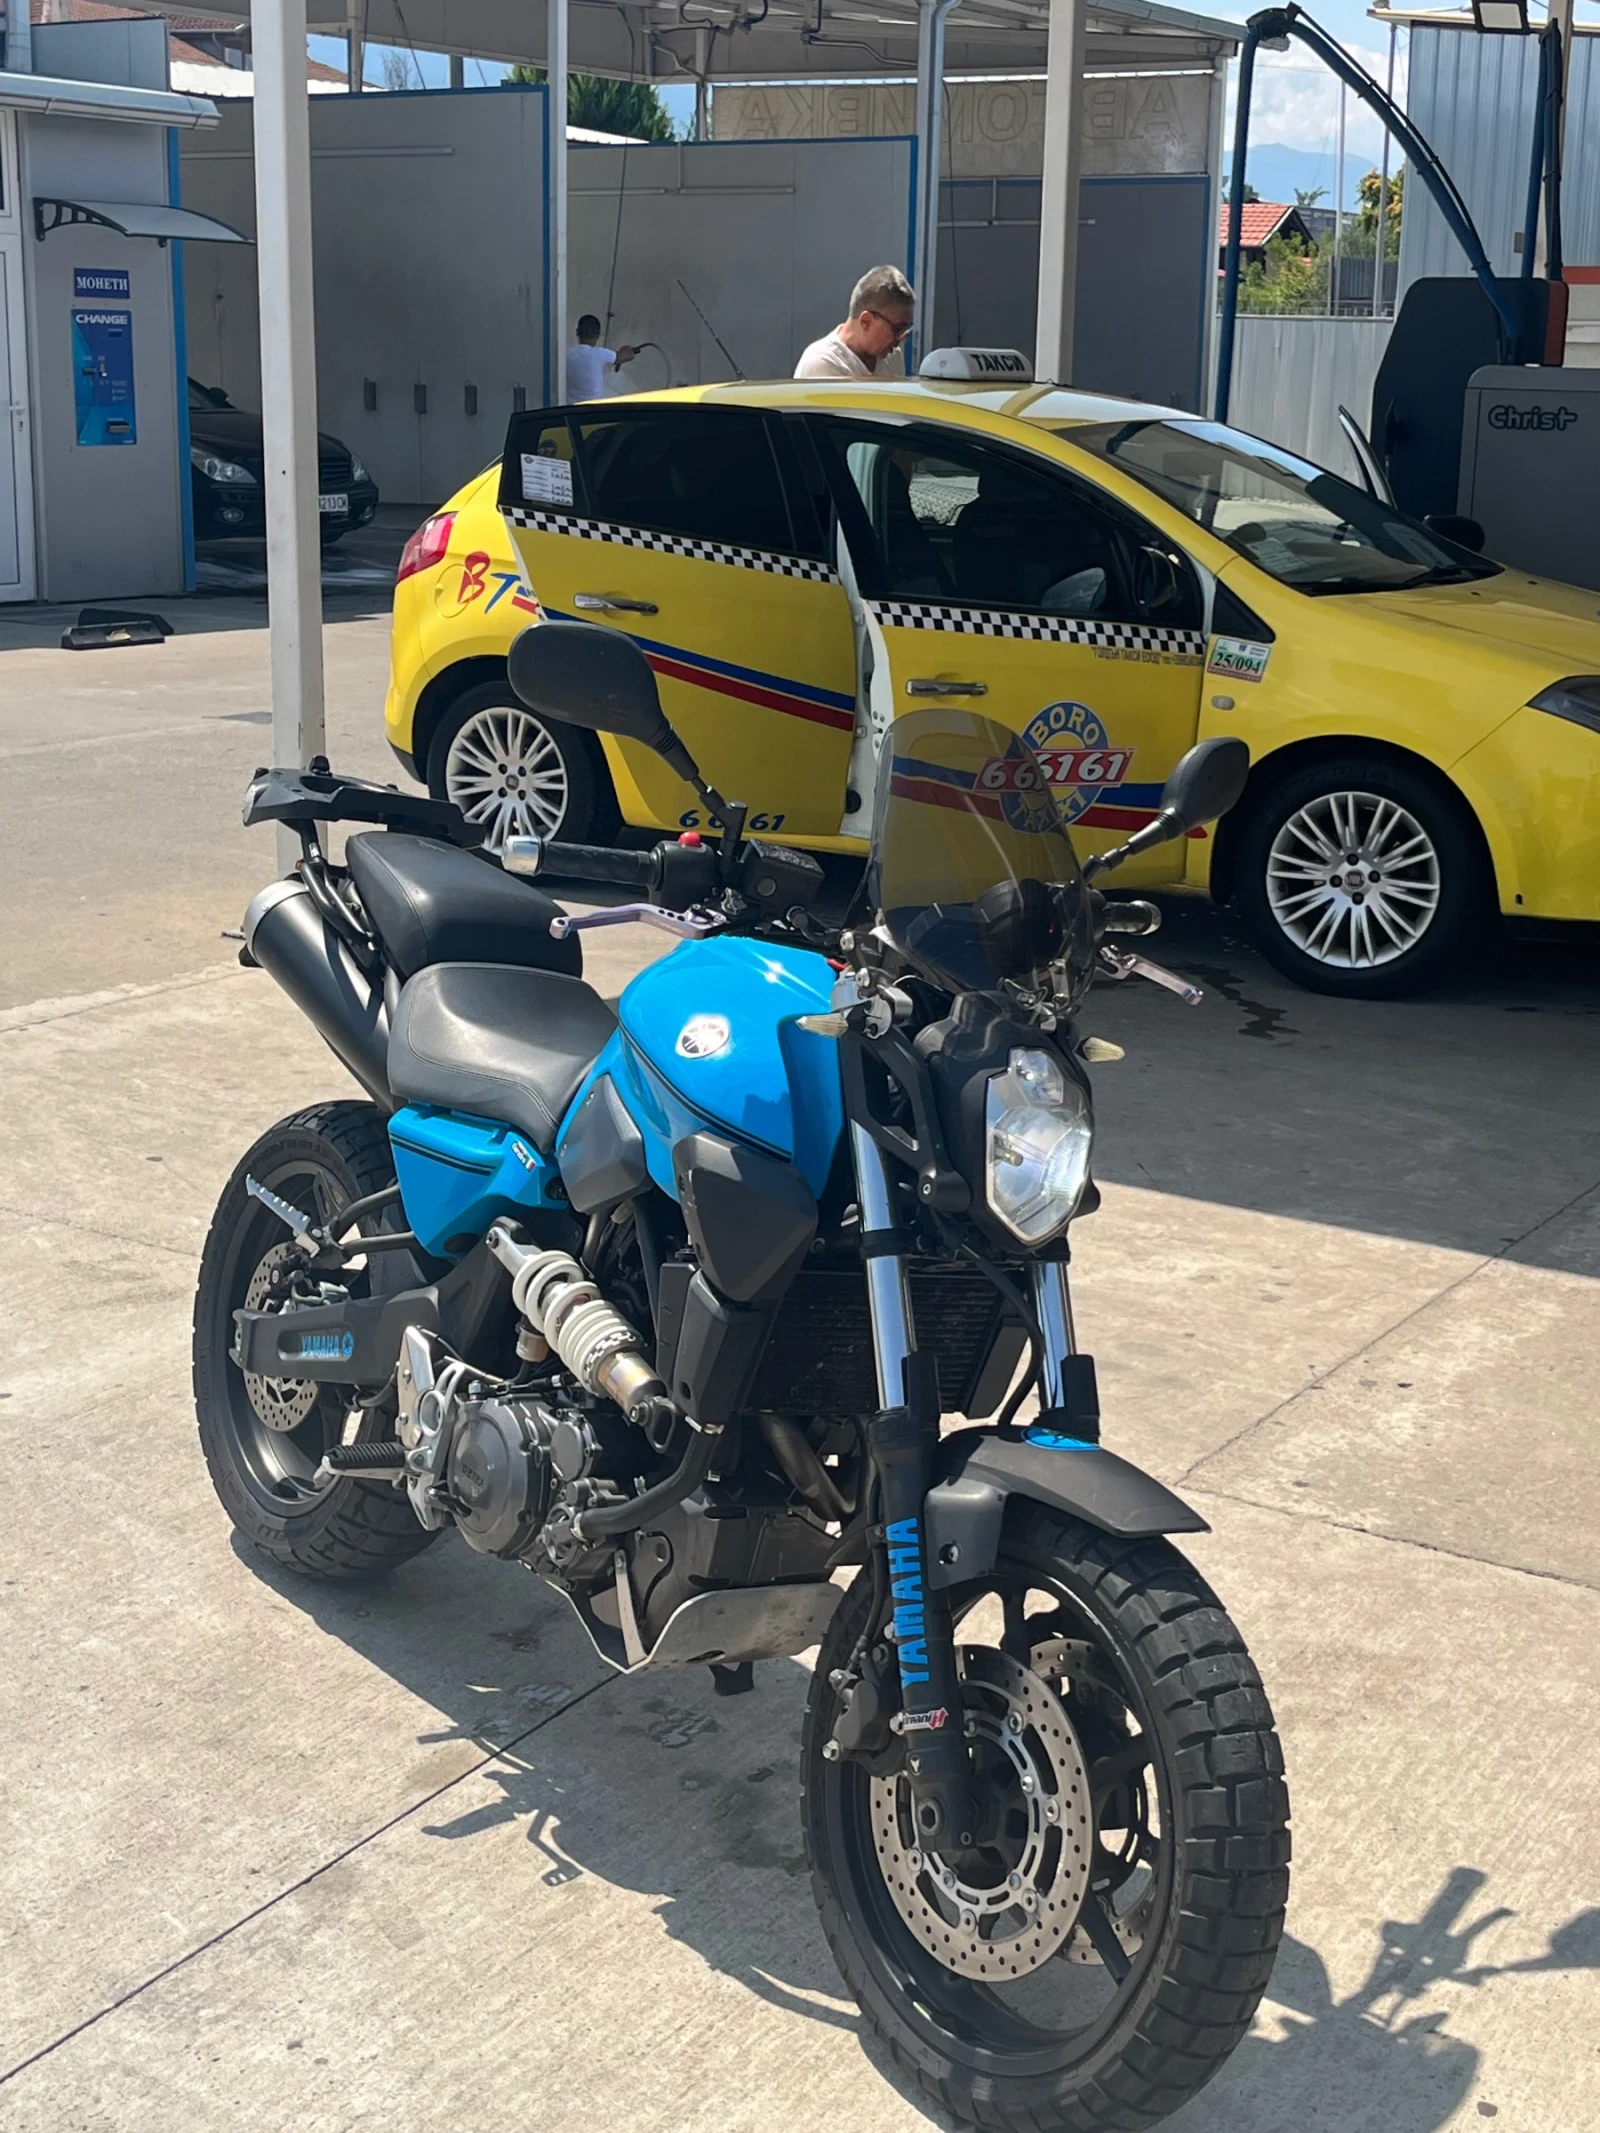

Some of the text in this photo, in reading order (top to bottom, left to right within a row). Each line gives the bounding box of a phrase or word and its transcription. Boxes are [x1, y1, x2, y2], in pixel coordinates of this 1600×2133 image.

[76, 276, 128, 291] МОНЕТИ
[75, 313, 128, 325] CHANGE
[969, 353, 1026, 372] ТАКСИ
[1487, 404, 1579, 431] Christ
[1214, 652, 1261, 675] 25/094
[1029, 706, 1100, 747] BORO
[301, 1335, 340, 1358] YAMAHA
[886, 1517, 930, 1689] YAMAHA
